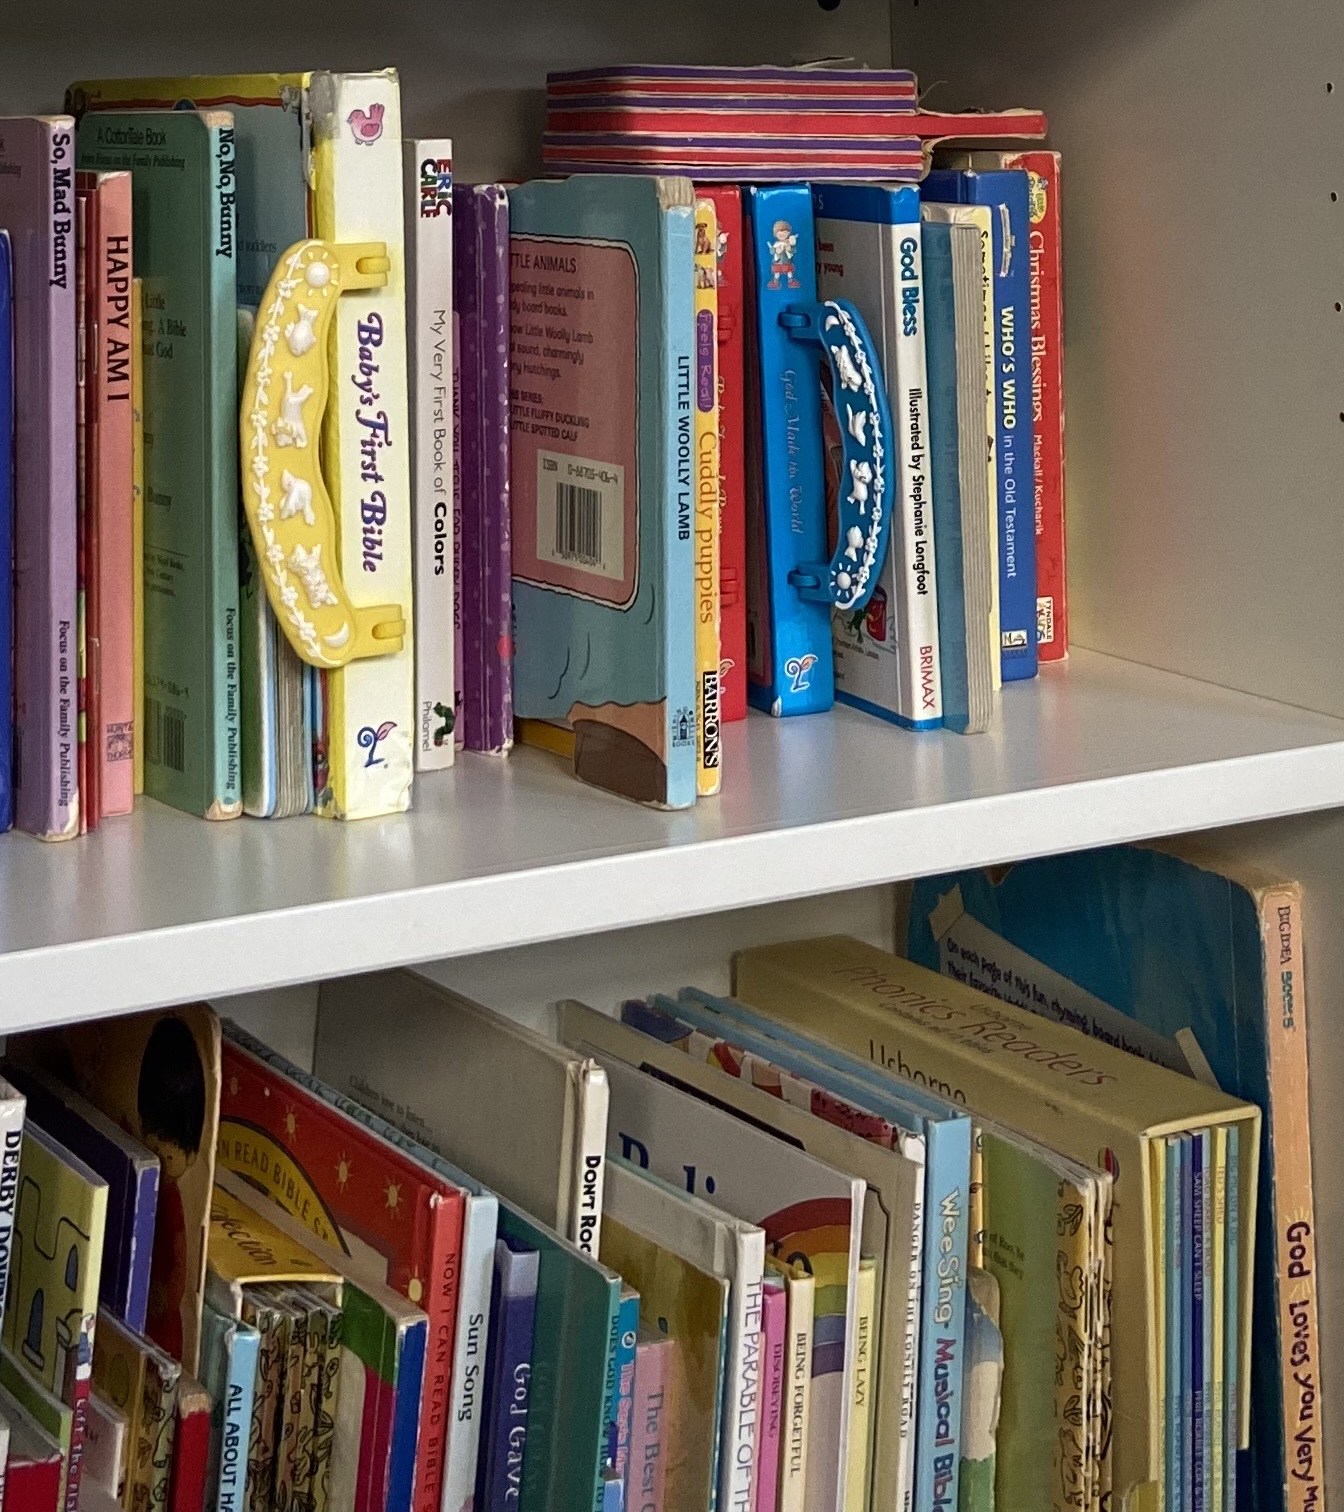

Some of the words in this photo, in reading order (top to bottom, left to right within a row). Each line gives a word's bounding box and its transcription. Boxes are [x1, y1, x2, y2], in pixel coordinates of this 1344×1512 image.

[50, 133, 71, 164] So,
[53, 166, 72, 215] Mad
[437, 158, 453, 217] ERIC
[215, 192, 236, 259] Bunny
[49, 219, 72, 290] Bunny
[533, 254, 577, 274] ANIMALS
[899, 236, 919, 282] God
[1029, 230, 1046, 331] Christmas
[106, 235, 130, 330] HAPPY
[428, 309, 447, 334] My
[901, 286, 919, 338] Bless
[107, 337, 130, 385] AM
[351, 311, 384, 407] Baby's
[430, 338, 447, 382] Very
[1000, 305, 1016, 374] WHO'S
[107, 392, 130, 403] I
[432, 386, 448, 421] First
[677, 356, 690, 411] LITTLE
[1002, 378, 1017, 430] WHO
[1030, 334, 1048, 424] Blessings
[555, 410, 591, 429] DUCKLING
[908, 387, 926, 451] Illustrated
[1004, 434, 1015, 449] in
[355, 409, 392, 483] First
[433, 424, 448, 472] Book
[677, 416, 691, 486] WOOLLY
[908, 454, 922, 472] by
[1004, 452, 1015, 474] the
[1033, 434, 1045, 470] Mackall
[433, 476, 448, 496] of
[695, 431, 718, 520] Cuddly
[1004, 477, 1017, 503] Old
[360, 489, 388, 574] Bible
[677, 492, 691, 542] LAMB
[908, 475, 928, 536] Stephanie
[1034, 481, 1046, 536] Kucharik
[434, 500, 448, 577] Colors
[1004, 506, 1017, 580] Testament
[694, 527, 720, 625] puppies
[914, 539, 930, 597] Longfoot
[59, 619, 71, 654] Focus
[225, 607, 237, 640] Focus
[59, 656, 70, 672] on
[226, 643, 237, 658] on
[226, 661, 237, 679] the
[919, 644, 936, 710] BRIMAX
[59, 675, 71, 695] the
[225, 682, 238, 723] Family
[57, 698, 71, 739] Family
[421, 699, 433, 752] Philomel
[58, 742, 72, 807] Publishing
[225, 726, 238, 790] Publishing
[834, 965, 967, 1022] Phonics
[958, 1018, 1119, 1087] Readers
[234, 1138, 269, 1174] READ
[271, 1163, 311, 1219] BIBLE
[442, 1252, 456, 1298] NOW
[1287, 1221, 1312, 1280] God
[744, 1275, 763, 1328] THE
[435, 1324, 449, 1364] CAN
[468, 1312, 485, 1356] Sun
[794, 1332, 807, 1380] BEING
[856, 1315, 870, 1364] BEING
[1288, 1299, 1314, 1368] Loves
[226, 1384, 244, 1419] ALL
[429, 1375, 445, 1426] READ
[458, 1364, 480, 1422] Song
[509, 1362, 532, 1416] God
[646, 1384, 665, 1434] The
[739, 1332, 762, 1435] PARABLE
[767, 1342, 784, 1440] DISOBEYING
[855, 1367, 868, 1408] LAZY
[933, 1338, 957, 1448] Musical
[1292, 1371, 1317, 1422] you
[219, 1421, 241, 1489] ABOUT
[789, 1383, 806, 1479] FORGETFUL
[1291, 1428, 1319, 1484] Very
[424, 1439, 441, 1494] BIBLE
[504, 1426, 527, 1504] Gave
[641, 1442, 662, 1498] Best
[735, 1443, 758, 1478] OF
